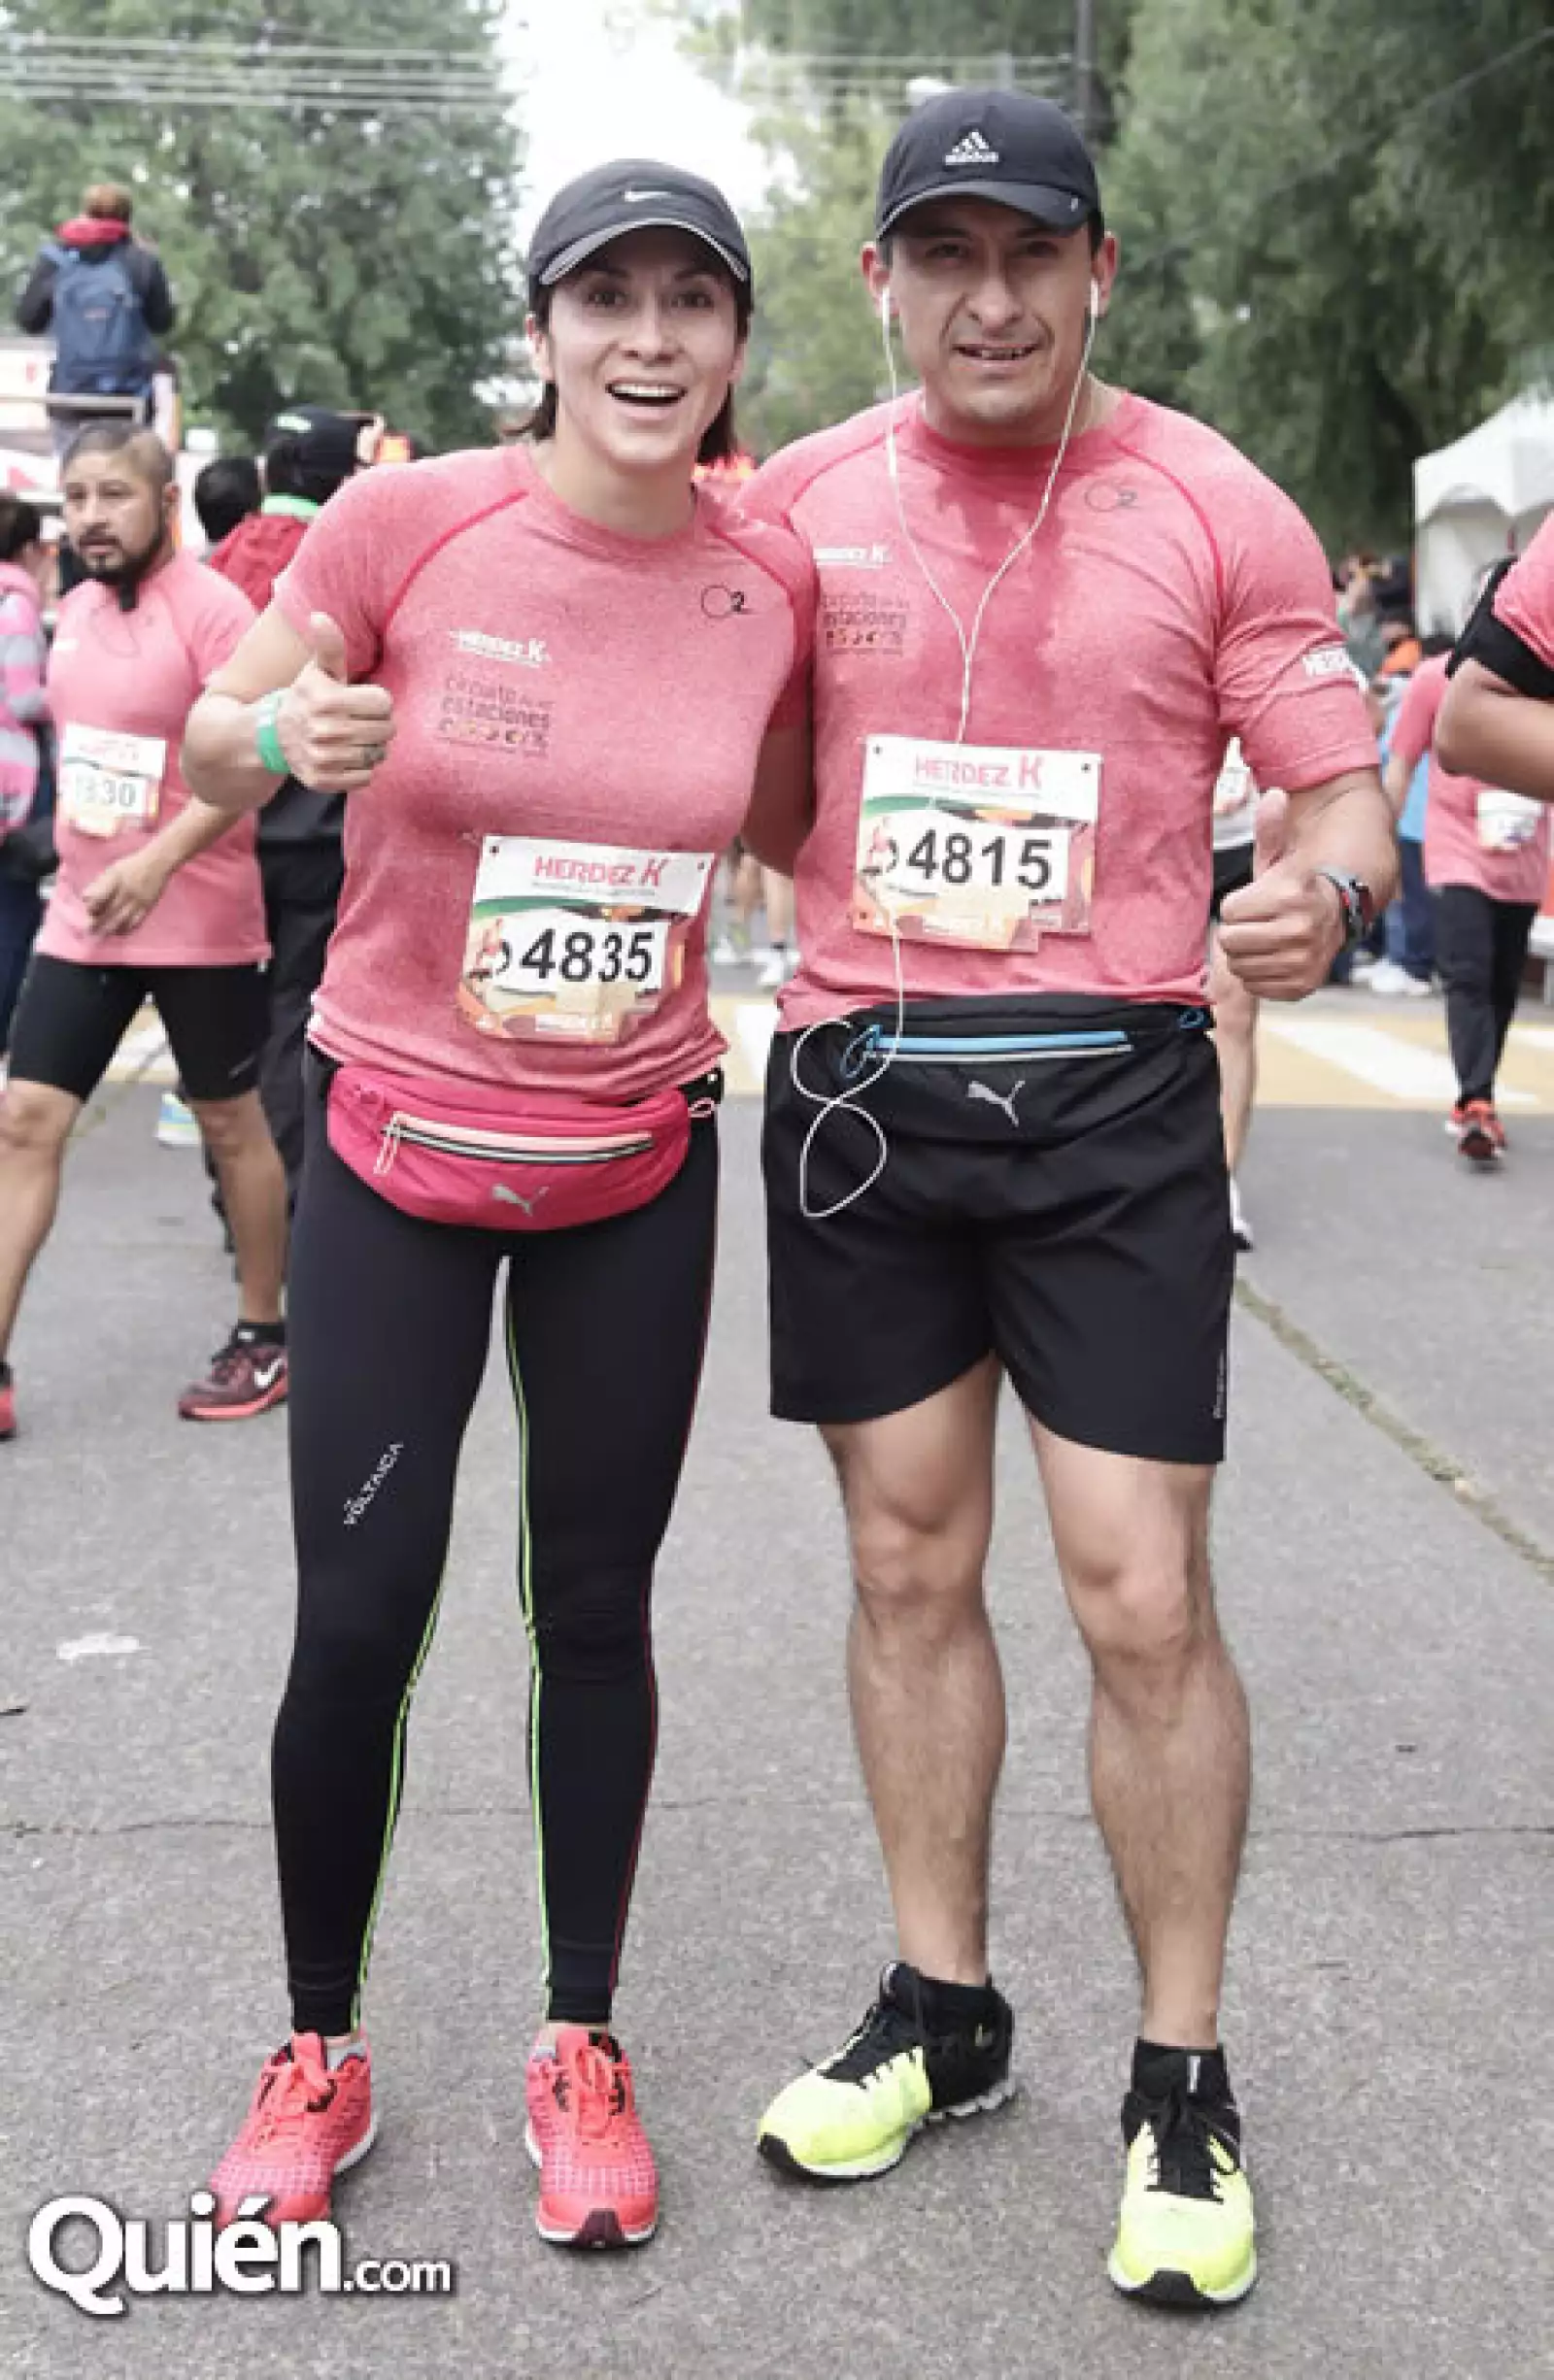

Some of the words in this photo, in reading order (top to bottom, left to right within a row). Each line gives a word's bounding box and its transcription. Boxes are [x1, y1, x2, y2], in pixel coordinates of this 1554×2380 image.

[914, 754, 1012, 788] HERDEZ
[1020, 754, 1044, 789] K
[532, 854, 636, 888] HERDEZ
[639, 856, 670, 888] K
[905, 827, 1054, 890] 4815
[520, 927, 656, 984] 4835
